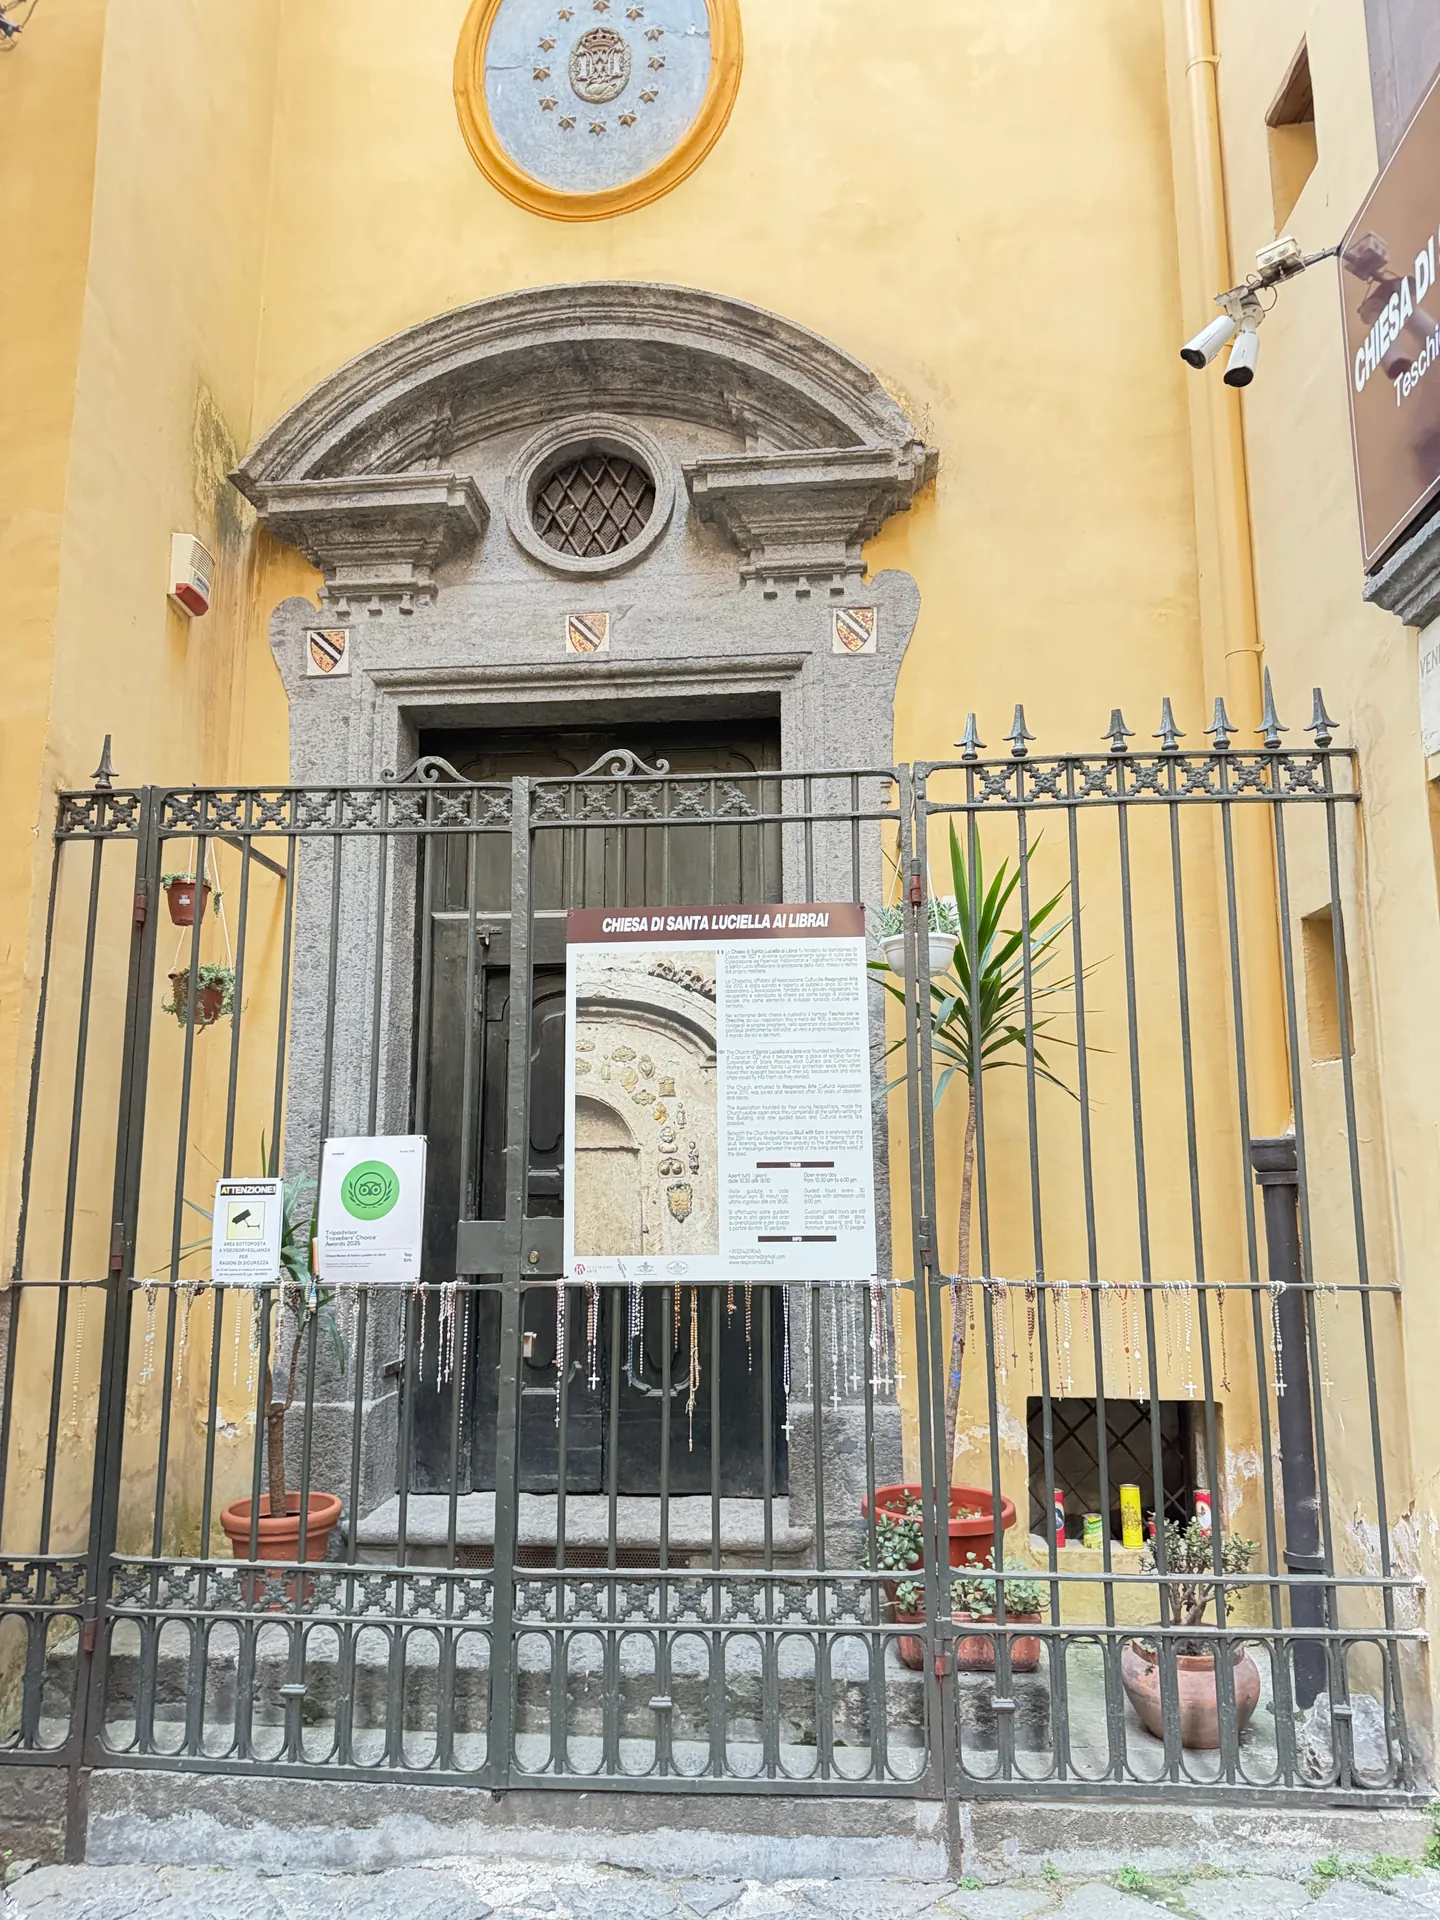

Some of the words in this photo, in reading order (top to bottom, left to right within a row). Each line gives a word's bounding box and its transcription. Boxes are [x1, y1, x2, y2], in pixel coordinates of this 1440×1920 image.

[1354, 275, 1413, 393] CHIESA
[1414, 235, 1436, 304] DI
[1420, 644, 1440, 678] VEN
[602, 916, 648, 932] CHIESA
[651, 916, 664, 931] DI
[666, 915, 709, 931] SANTA
[711, 914, 771, 929] LUCIELLA
[773, 914, 786, 928] AI
[788, 912, 829, 928] LIBRAI
[221, 1186, 276, 1194] ATTENZIONE!
